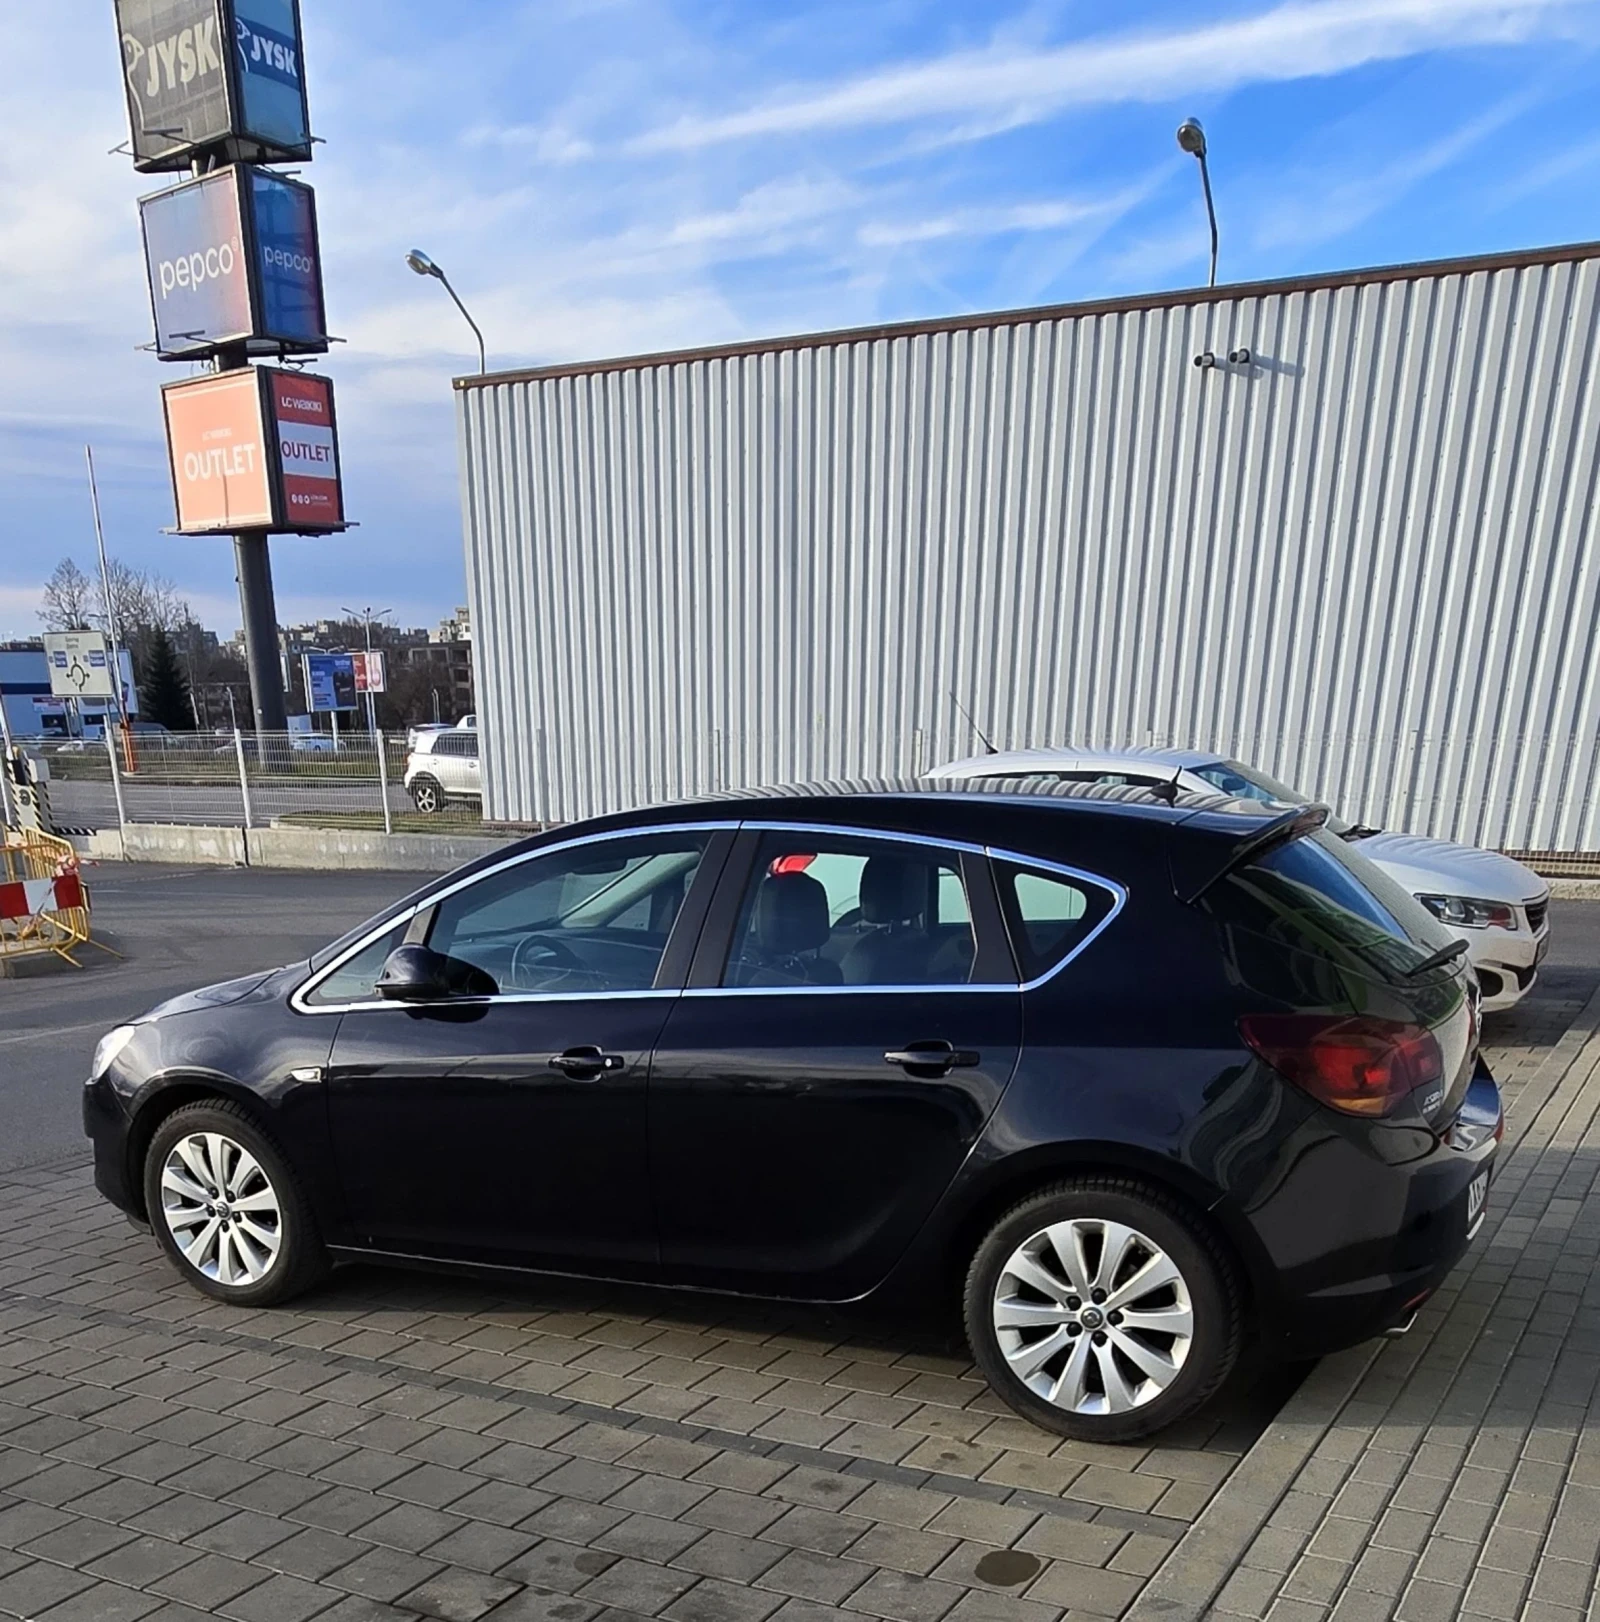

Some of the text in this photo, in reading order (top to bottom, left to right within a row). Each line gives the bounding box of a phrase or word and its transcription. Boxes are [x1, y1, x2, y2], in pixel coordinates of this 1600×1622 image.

[146, 15, 220, 97] JYSK
[250, 35, 298, 78] JYSK
[159, 243, 234, 299] pepco
[183, 443, 256, 482] OUTLET
[281, 440, 331, 462] OUTLET
